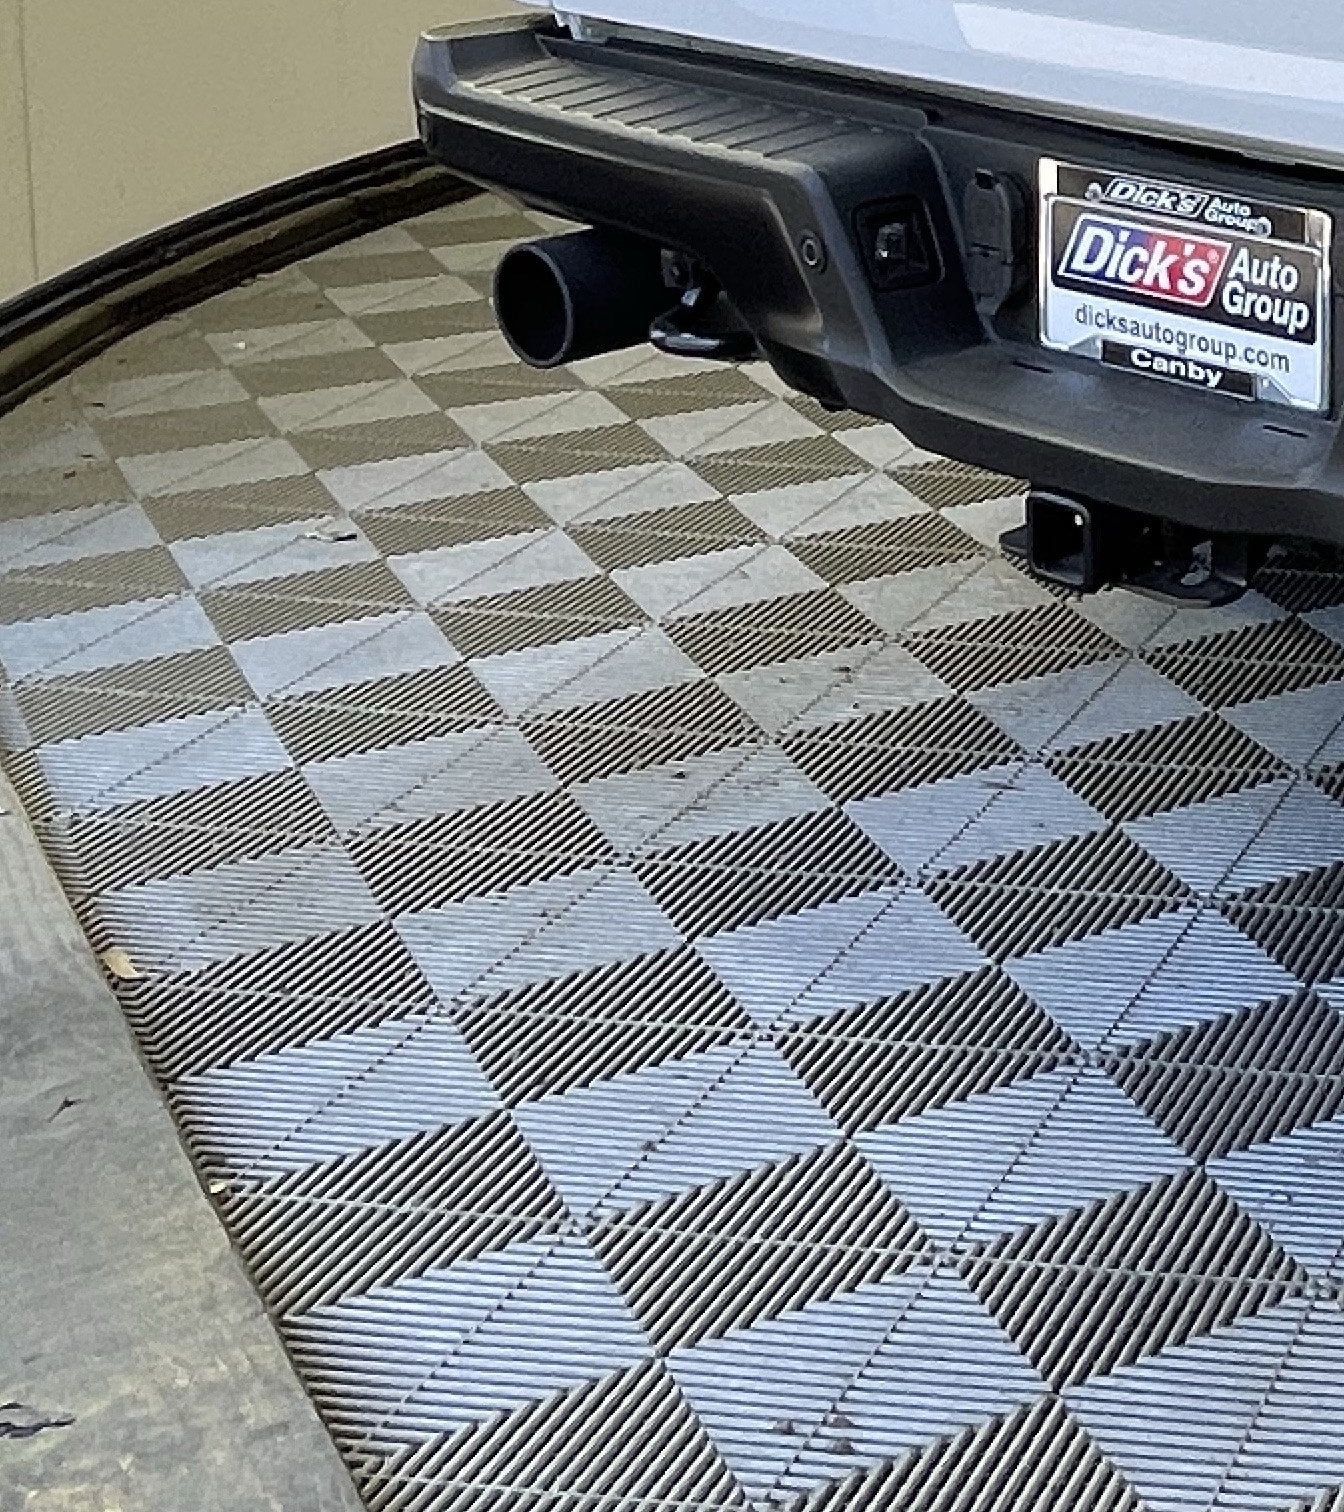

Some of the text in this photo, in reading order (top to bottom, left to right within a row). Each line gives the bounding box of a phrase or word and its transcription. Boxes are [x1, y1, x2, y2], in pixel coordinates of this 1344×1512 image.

[1204, 209, 1259, 234] Group
[1210, 197, 1251, 216] Auto
[1070, 225, 1211, 297] Dick's
[1229, 247, 1299, 293] Auto
[1221, 282, 1310, 335] Group
[1074, 303, 1291, 373] dicksautogroup.com
[1129, 348, 1224, 388] Canby
